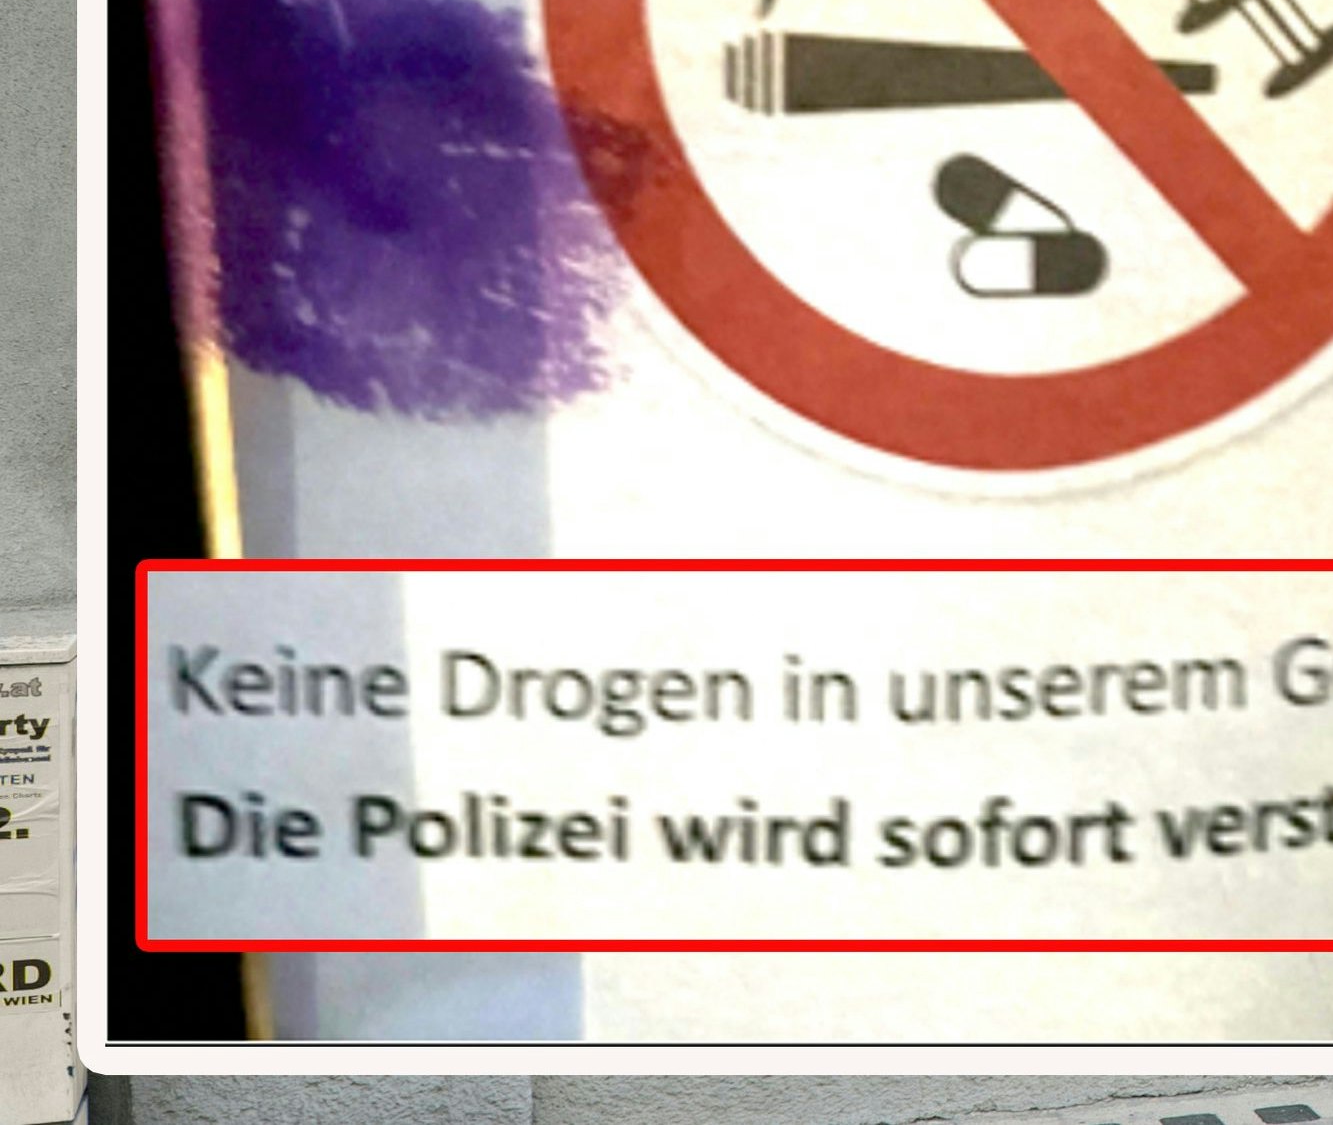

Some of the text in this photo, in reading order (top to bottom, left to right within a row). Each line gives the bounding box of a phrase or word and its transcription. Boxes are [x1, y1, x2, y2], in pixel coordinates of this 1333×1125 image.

[0, 677, 42, 697] .at
[167, 644, 410, 719] Keine
[439, 648, 755, 738] Drogen
[781, 653, 860, 723] in
[887, 654, 1250, 725] unserem
[175, 790, 325, 860] Die
[349, 789, 630, 861] Polizei
[658, 796, 852, 868] wird
[876, 794, 1134, 870] sofort
[4, 994, 52, 1006] WIEN
